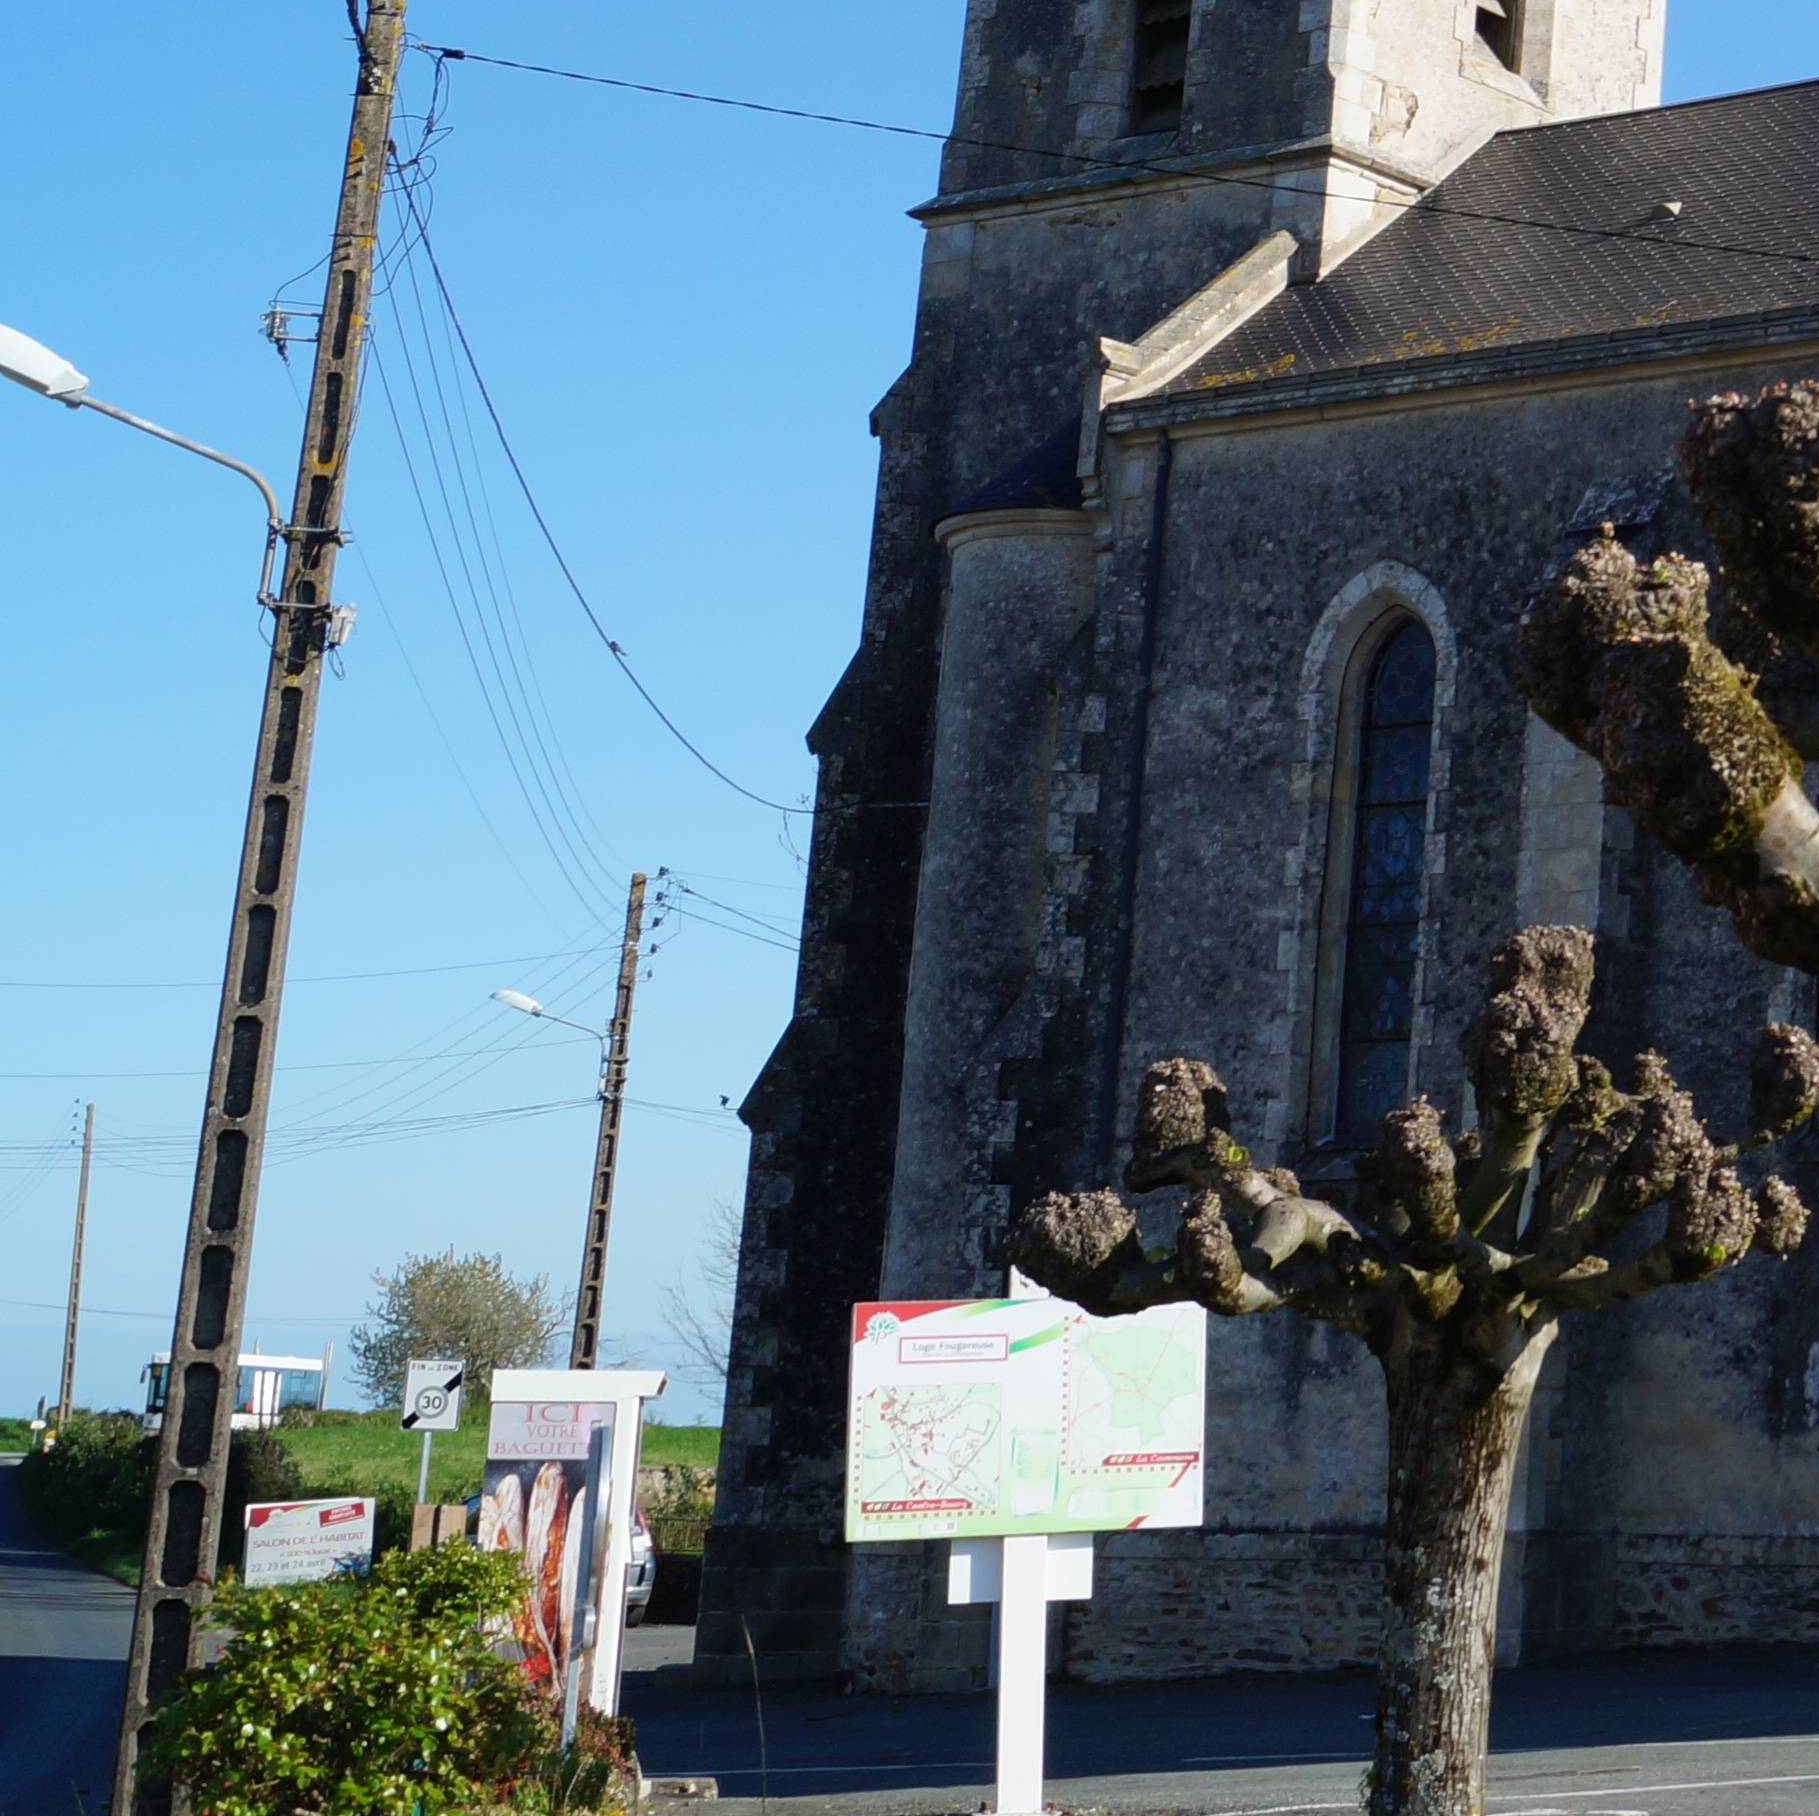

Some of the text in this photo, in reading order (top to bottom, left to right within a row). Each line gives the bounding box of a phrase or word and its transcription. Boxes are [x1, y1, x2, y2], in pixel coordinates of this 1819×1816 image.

[436, 1363, 459, 1371] ZONE
[421, 1395, 443, 1410] 30
[523, 1404, 581, 1422] ICI
[526, 1424, 578, 1438] VOTRE
[253, 1537, 290, 1548] SALON
[292, 1536, 307, 1545] DE
[319, 1531, 365, 1543] HABITAT
[293, 1560, 304, 1568] 24
